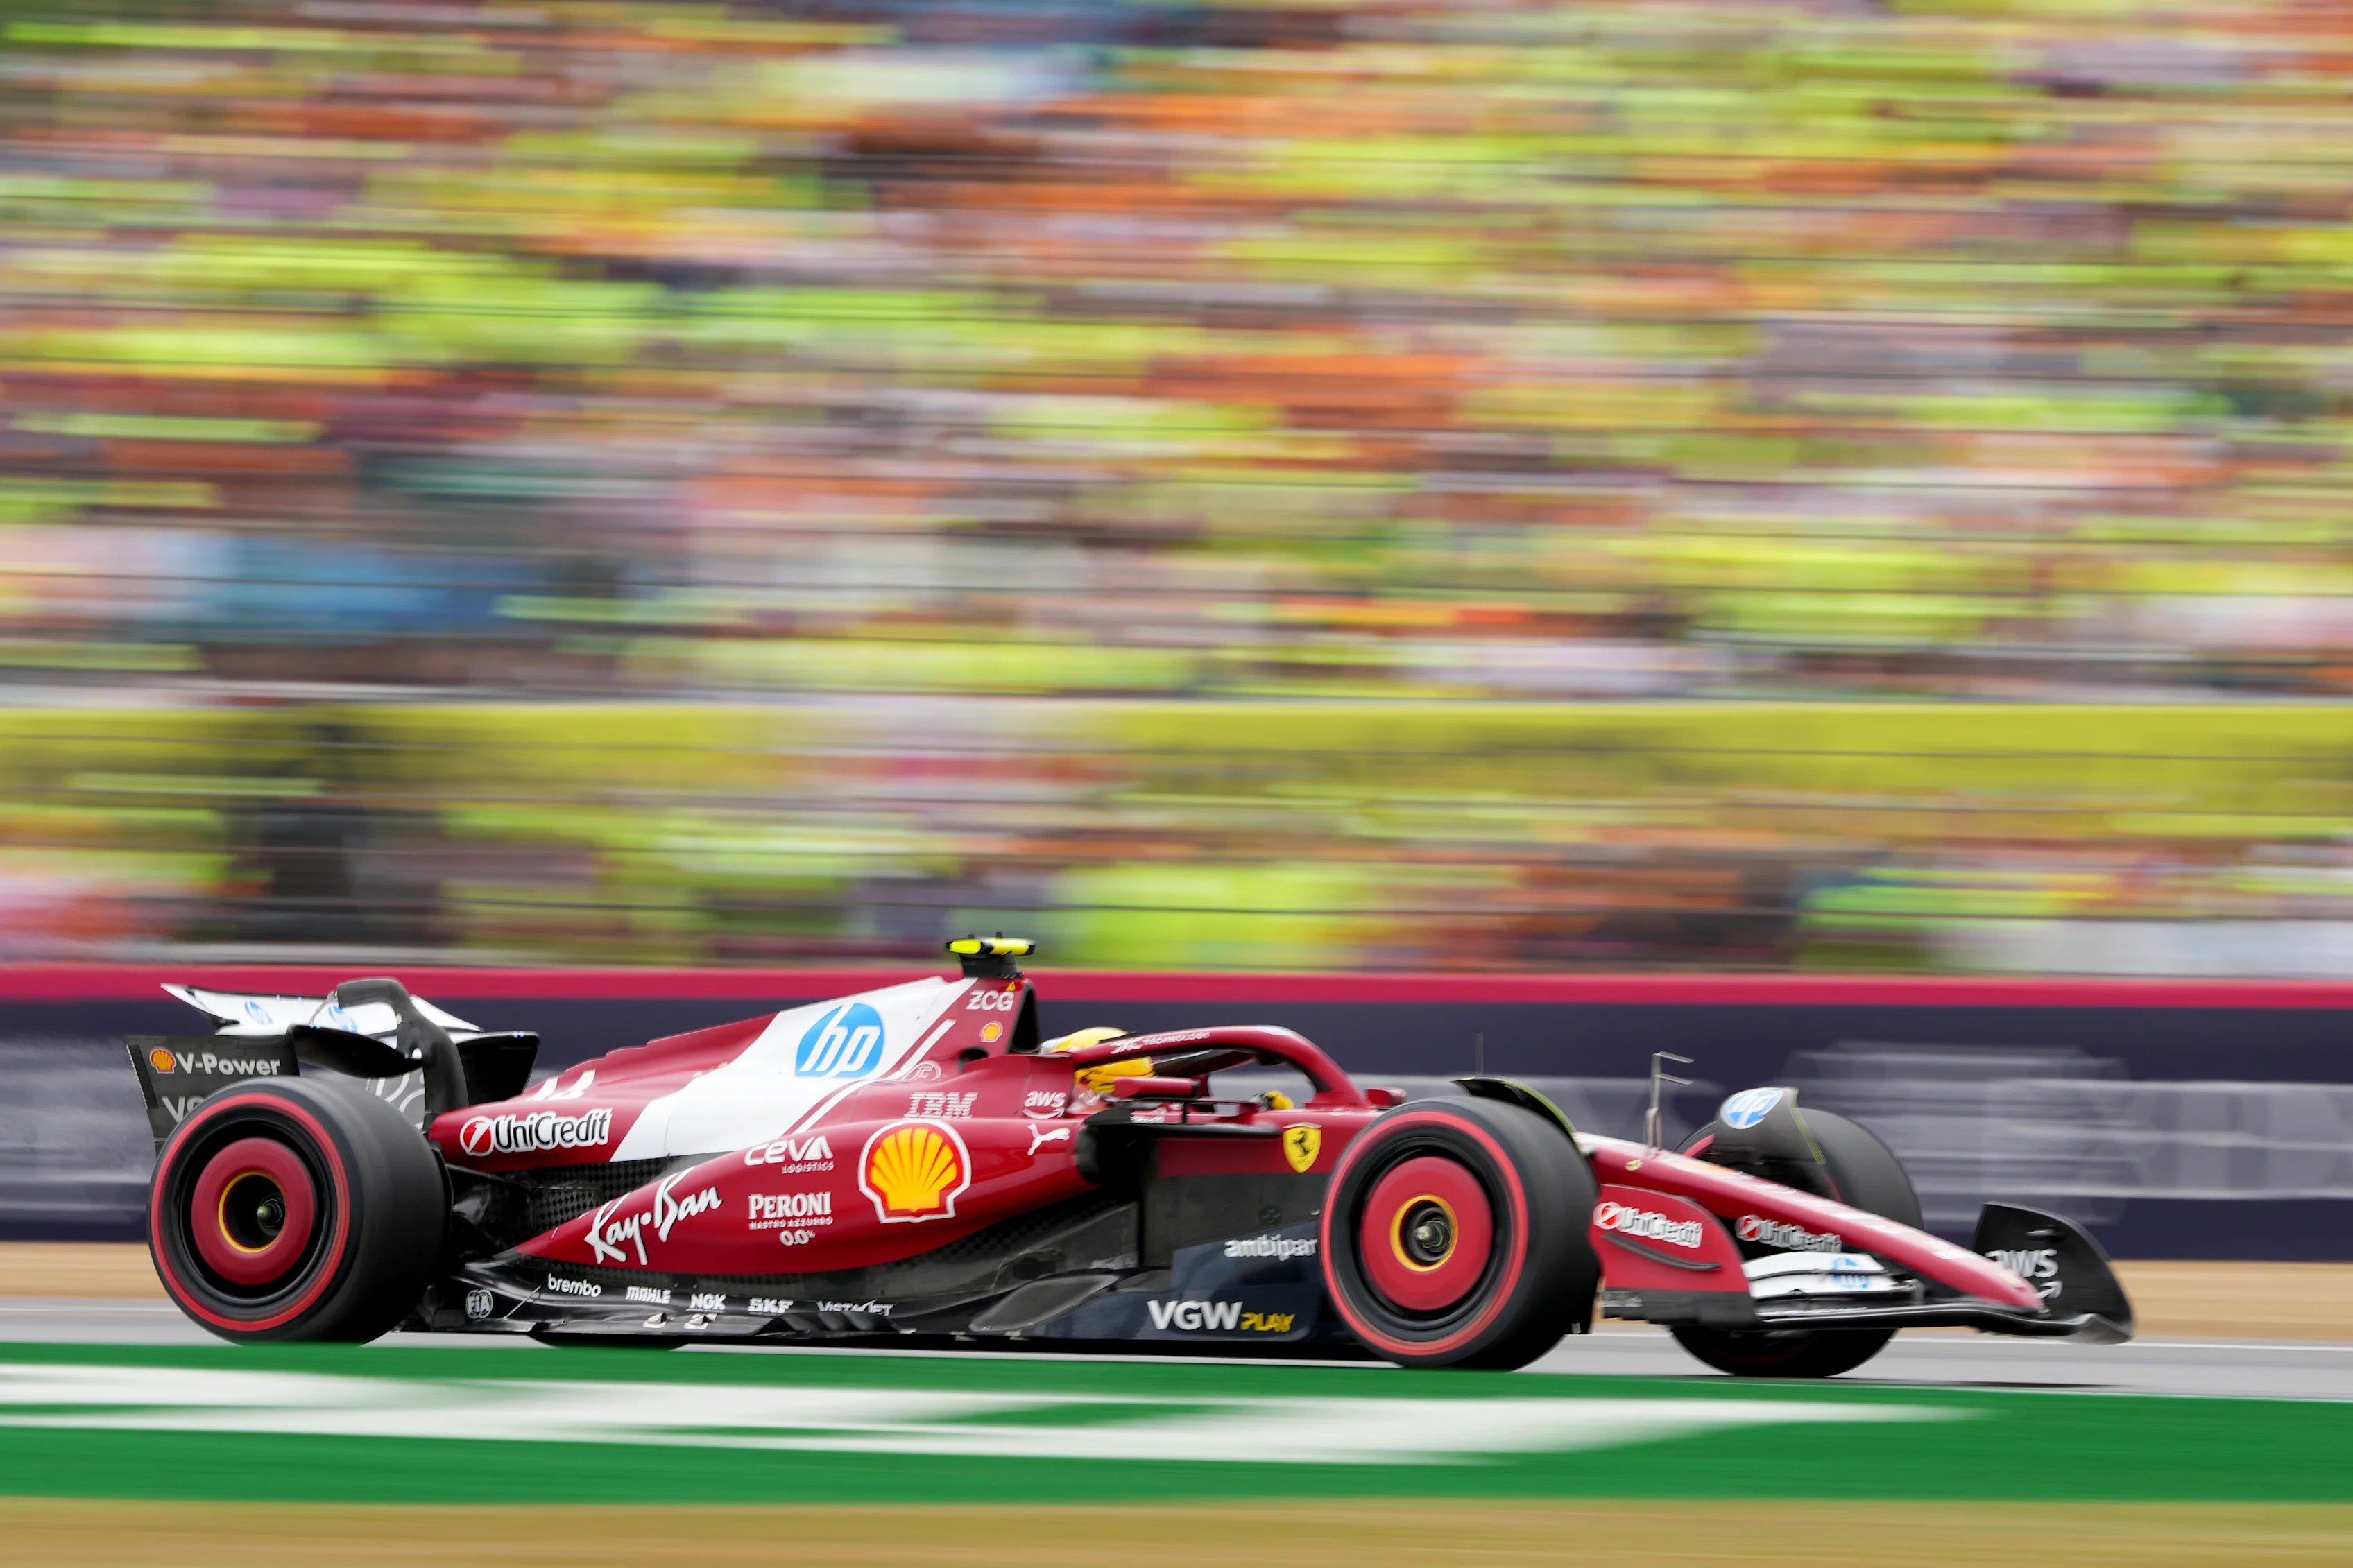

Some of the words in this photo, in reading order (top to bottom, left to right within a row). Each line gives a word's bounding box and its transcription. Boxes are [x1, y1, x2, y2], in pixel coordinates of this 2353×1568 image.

[965, 990, 1015, 1012] ZCG
[797, 1003, 883, 1078] hp
[176, 1052, 280, 1076] V-Power
[903, 1092, 979, 1119] IBM
[1025, 1090, 1067, 1108] aws
[495, 1109, 611, 1151] UniCredit
[781, 1161, 835, 1174] LOGISTICS
[748, 1191, 832, 1220] PERONI
[748, 1219, 787, 1230] NASTRO
[787, 1216, 833, 1227] AZZURRO
[1224, 1234, 1318, 1261] ambipar
[547, 1273, 602, 1298] brembo
[626, 1286, 671, 1304] MAHLE
[467, 1294, 492, 1314] FIA
[689, 1293, 727, 1311] NGK
[747, 1298, 794, 1314] SKF
[1146, 1299, 1244, 1331] VGW
[1240, 1312, 1296, 1332] PLAY
